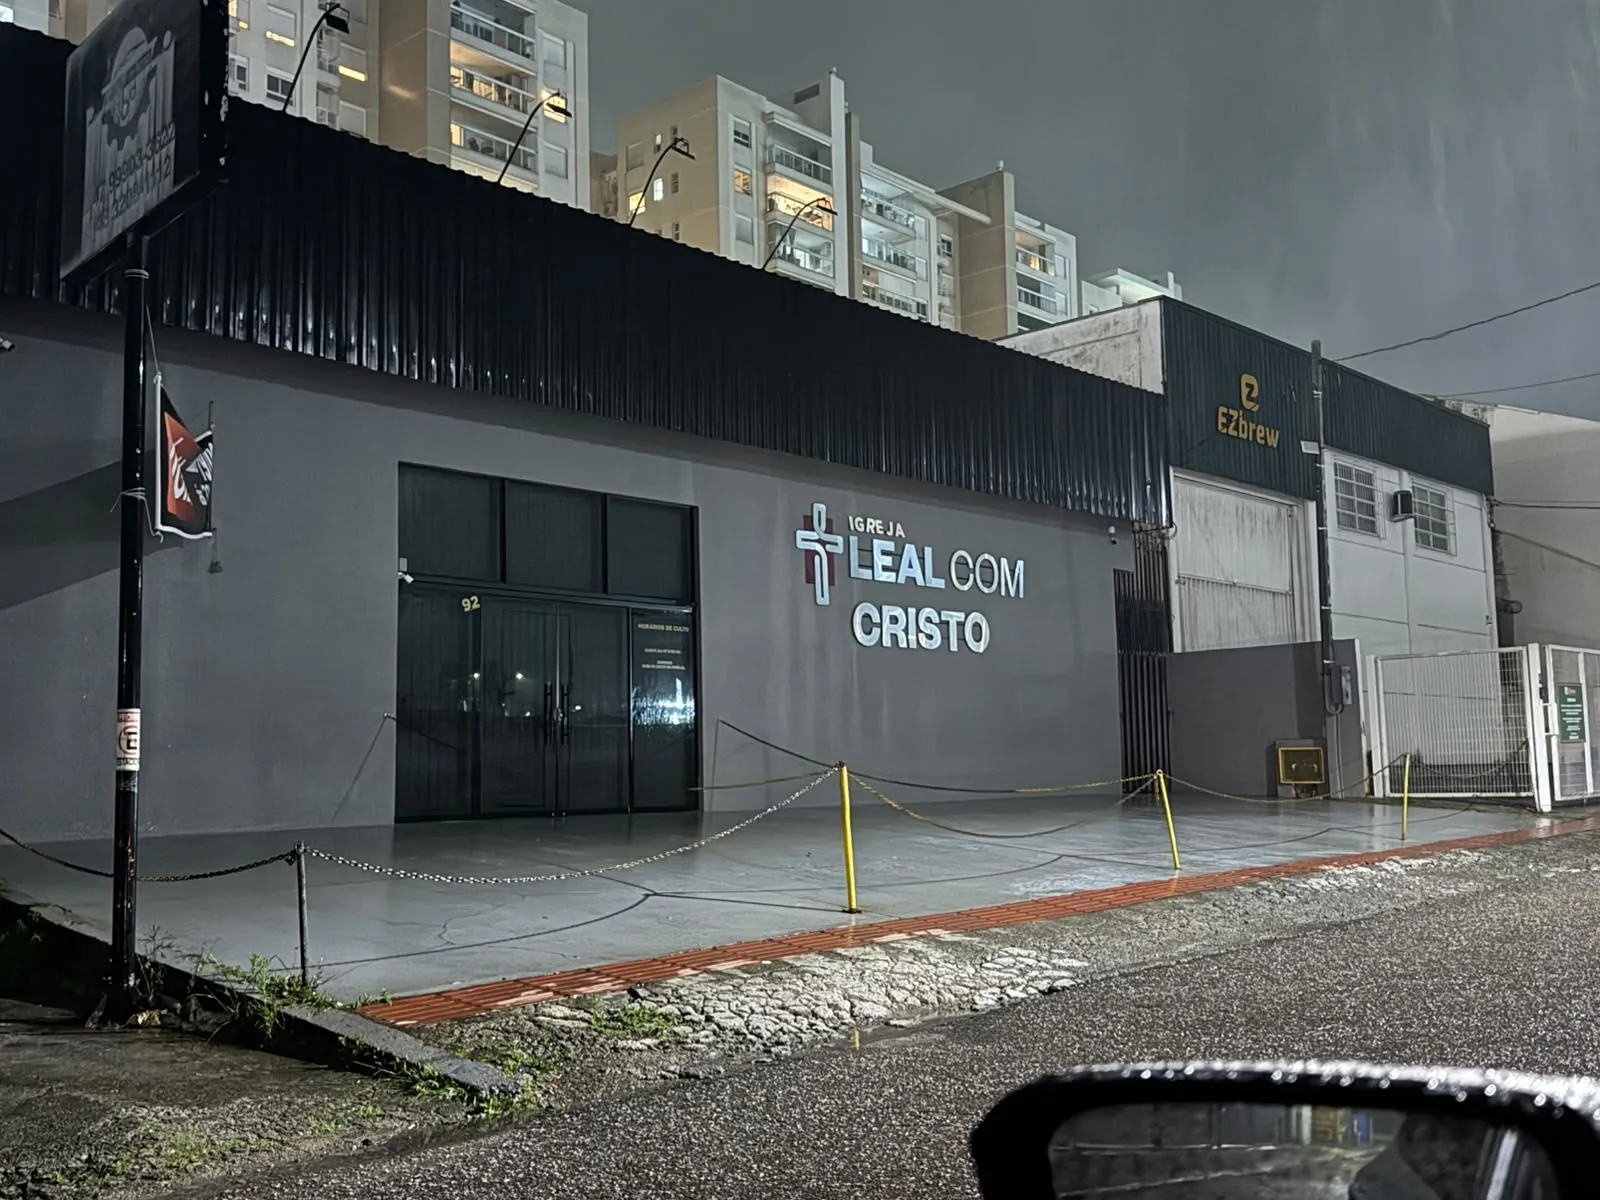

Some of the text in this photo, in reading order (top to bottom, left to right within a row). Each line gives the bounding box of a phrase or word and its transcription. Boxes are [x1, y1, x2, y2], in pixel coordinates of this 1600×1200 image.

[1218, 406, 1279, 449] EZbrew
[849, 516, 906, 538] IGREJA
[850, 535, 1025, 599] LEAL COM
[461, 595, 480, 612] 92
[853, 602, 990, 653] CRISTO
